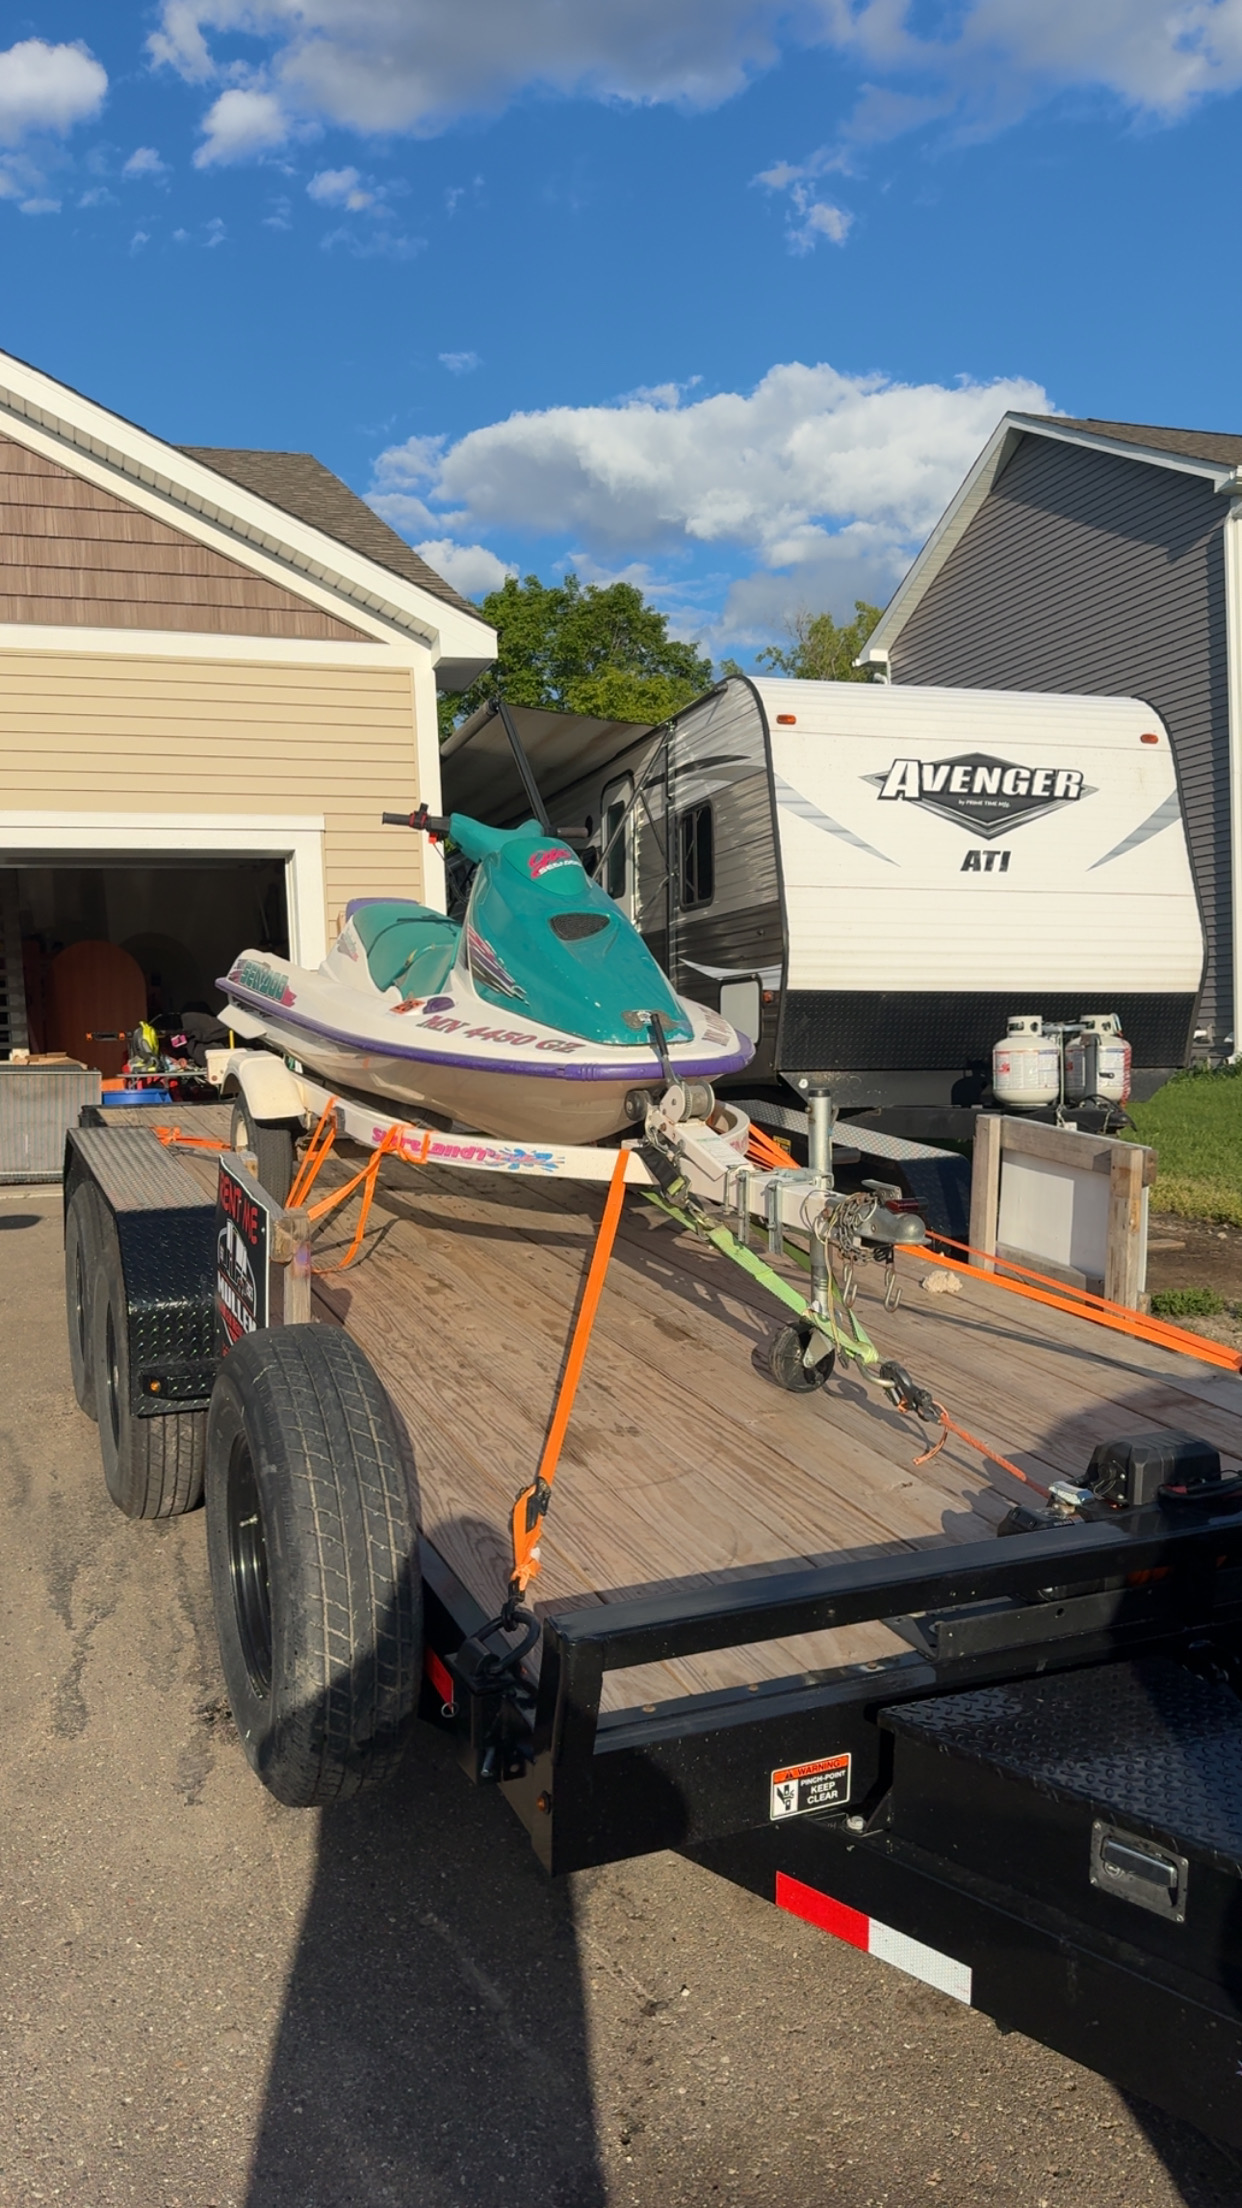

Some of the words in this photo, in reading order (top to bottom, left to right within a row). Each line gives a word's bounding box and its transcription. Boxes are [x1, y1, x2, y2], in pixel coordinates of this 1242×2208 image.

[877, 758, 1084, 801] AVENGER
[960, 850, 1011, 872] ATI
[416, 1015, 470, 1033] MN
[463, 1026, 538, 1046] 4450
[218, 1170, 242, 1223] RENT
[242, 1198, 258, 1245] ME
[797, 1760, 840, 1776] WARNING
[800, 1769, 847, 1787] PINCH-POINT
[807, 1790, 839, 1805] CLEAR
[810, 1781, 836, 1795] KEEP
